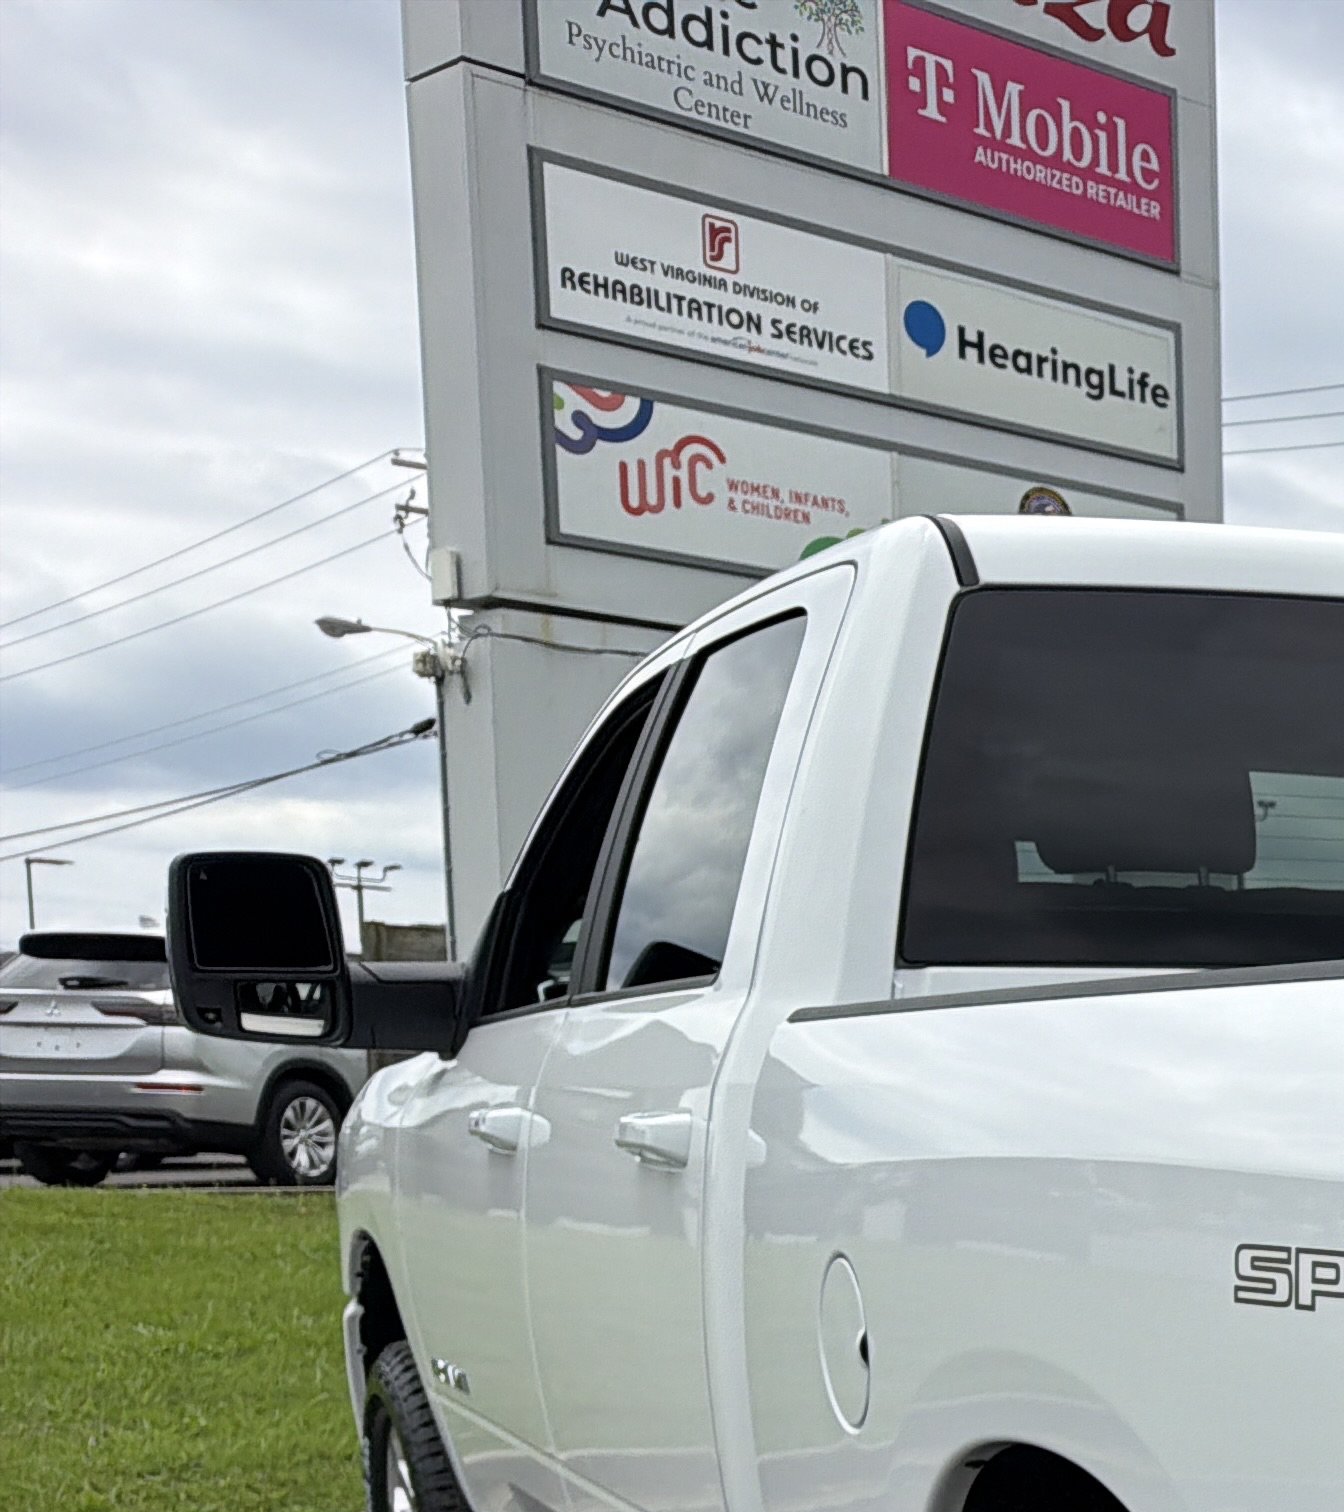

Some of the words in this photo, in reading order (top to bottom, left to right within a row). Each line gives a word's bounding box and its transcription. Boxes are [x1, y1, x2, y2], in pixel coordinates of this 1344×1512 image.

[566, 20, 696, 82] Psychiatric
[702, 71, 744, 97] and
[751, 77, 849, 128] Wellness
[596, 0, 869, 101] Addiction
[673, 86, 752, 130] Center
[971, 67, 1161, 190] Mobile
[973, 145, 1084, 196] AUTHORIZED
[1086, 180, 1161, 220] RETAILER
[560, 266, 763, 336] REHABILITATION
[770, 316, 876, 362] SERVICES
[614, 250, 657, 275] WEST
[661, 261, 729, 293] VIRGINIA
[732, 282, 797, 309] DIVISION
[799, 297, 820, 315] OF
[957, 324, 1171, 409] HearingLife
[725, 477, 786, 504] WOMEN,
[788, 488, 850, 517] INFANTS,
[727, 496, 738, 512] &
[740, 498, 812, 526] CHILDREN
